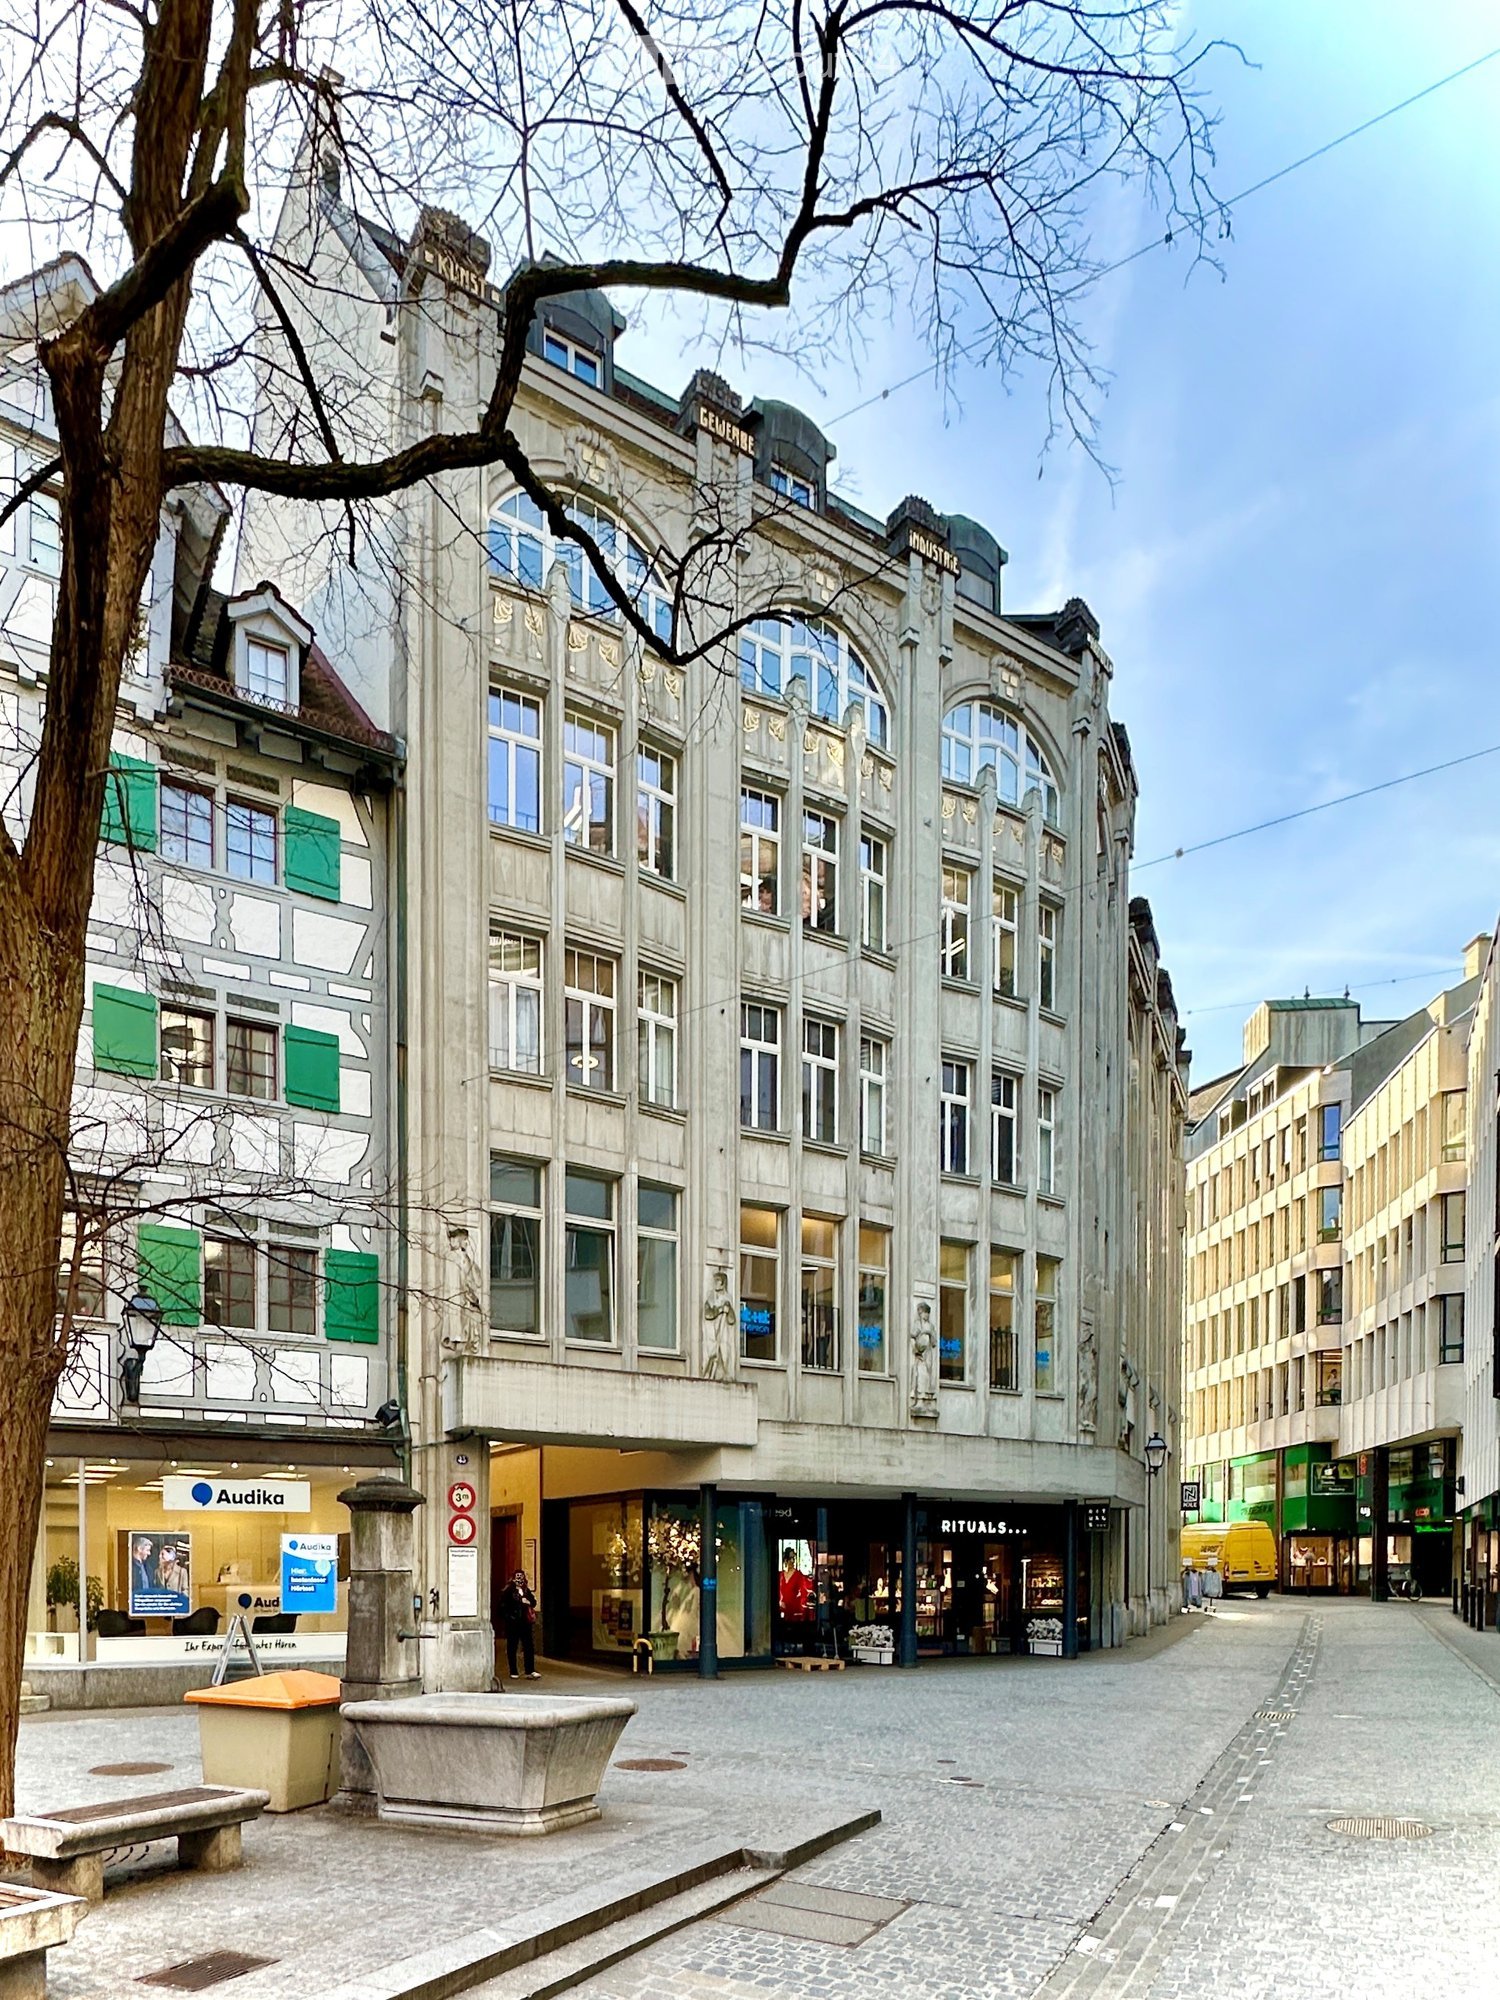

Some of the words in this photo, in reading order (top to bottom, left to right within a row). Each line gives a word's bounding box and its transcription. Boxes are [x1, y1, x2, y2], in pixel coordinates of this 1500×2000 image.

[438, 254, 487, 299] KUNST
[700, 406, 755, 456] GEWERBE
[216, 1488, 284, 1505] Audika
[455, 1493, 462, 1502] 3
[941, 1520, 1028, 1534] RITUALS...
[299, 1543, 332, 1551] Audika
[254, 1596, 280, 1608] Aud
[184, 1641, 200, 1652] Ihr
[201, 1640, 224, 1653] Exper
[255, 1639, 272, 1650] utes
